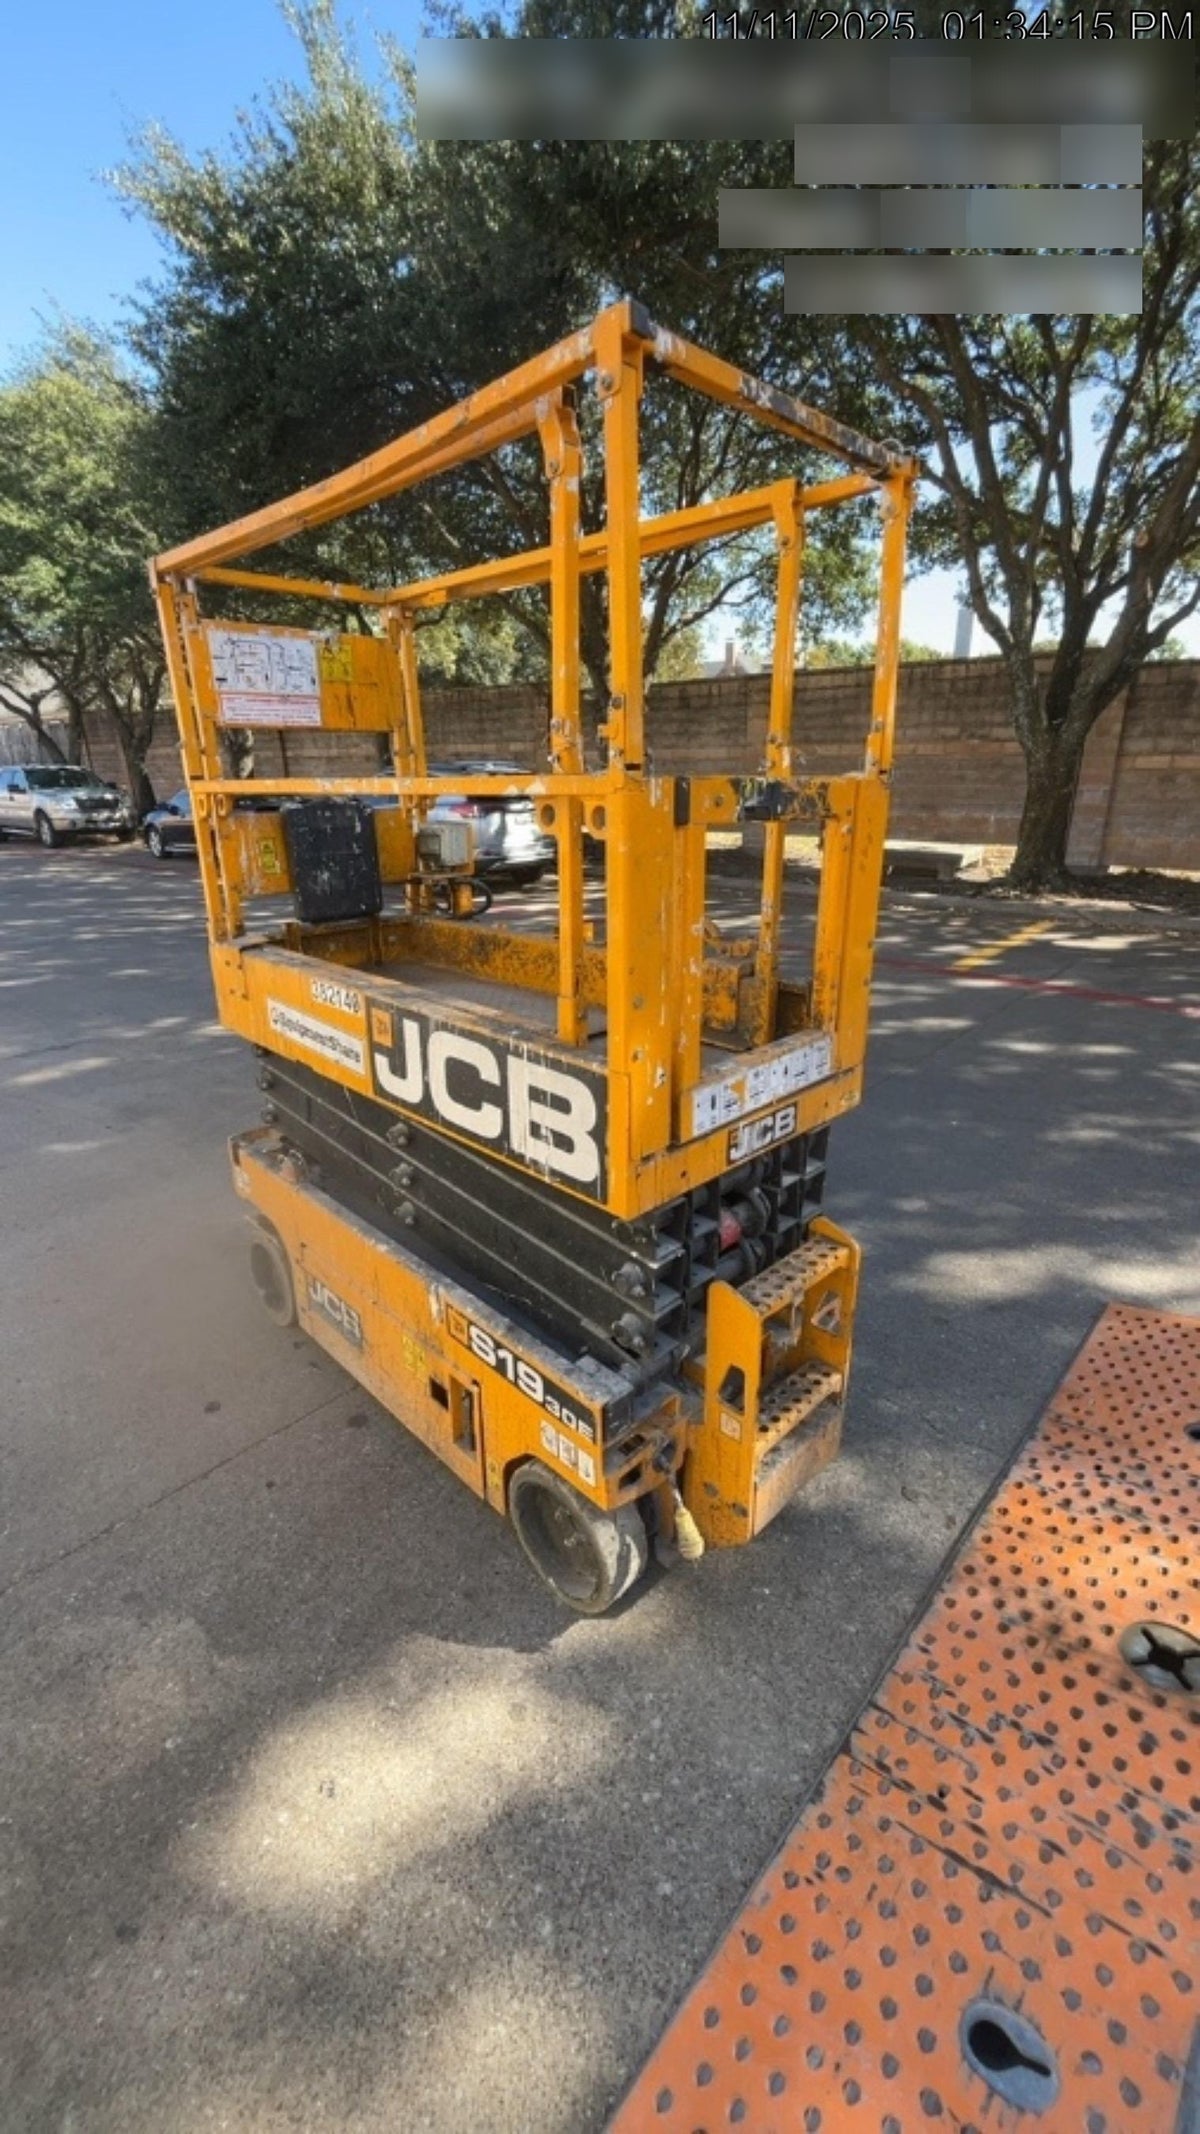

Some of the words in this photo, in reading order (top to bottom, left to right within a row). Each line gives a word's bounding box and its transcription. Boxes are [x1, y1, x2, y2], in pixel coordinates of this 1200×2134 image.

[373, 1017, 598, 1182] JCB
[729, 1105, 796, 1161] JCB
[308, 1279, 361, 1339] JCB
